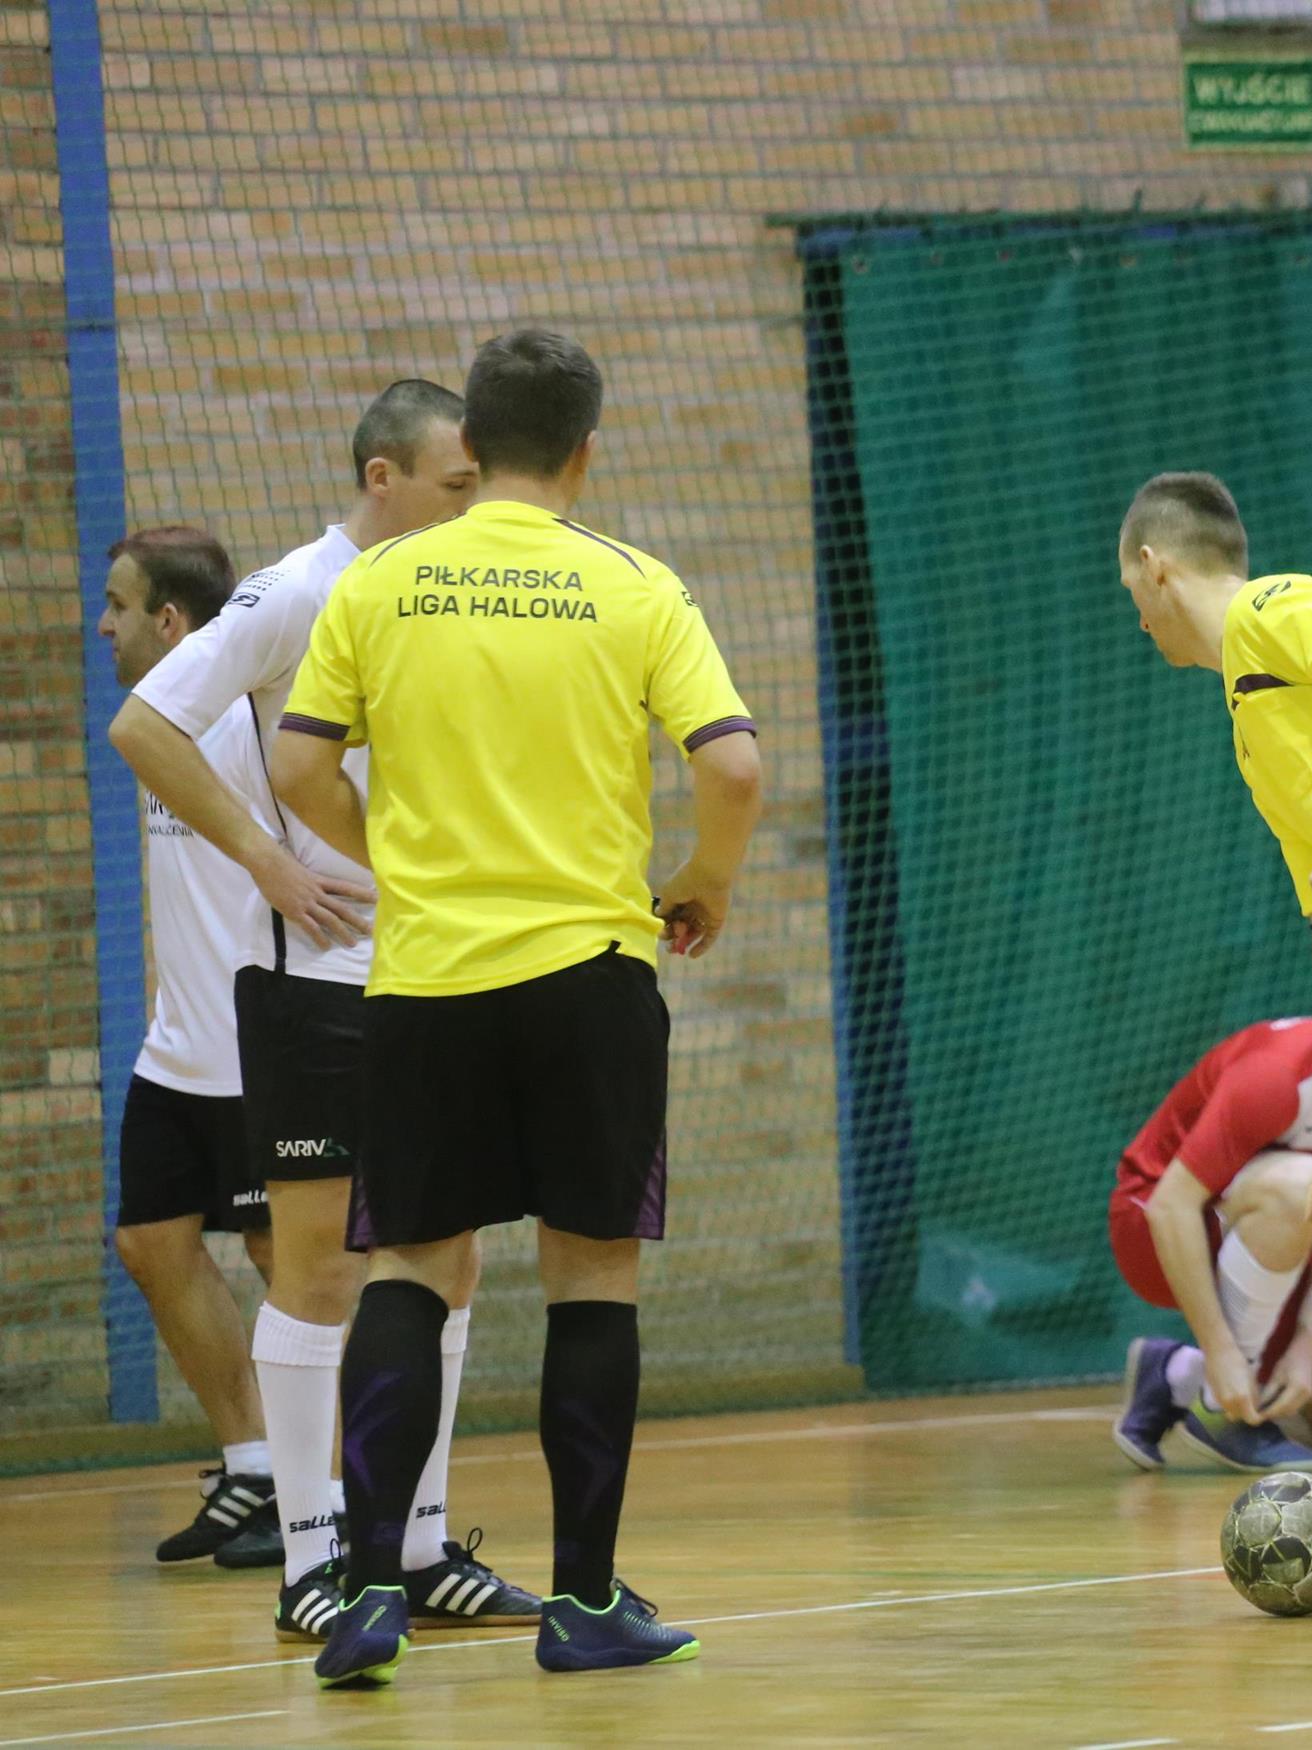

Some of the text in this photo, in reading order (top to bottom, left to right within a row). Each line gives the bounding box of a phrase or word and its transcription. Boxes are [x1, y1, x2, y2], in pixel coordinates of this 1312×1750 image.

[415, 565, 584, 592] PIŁKARSKA
[398, 594, 598, 622] LIGA HALOWA
